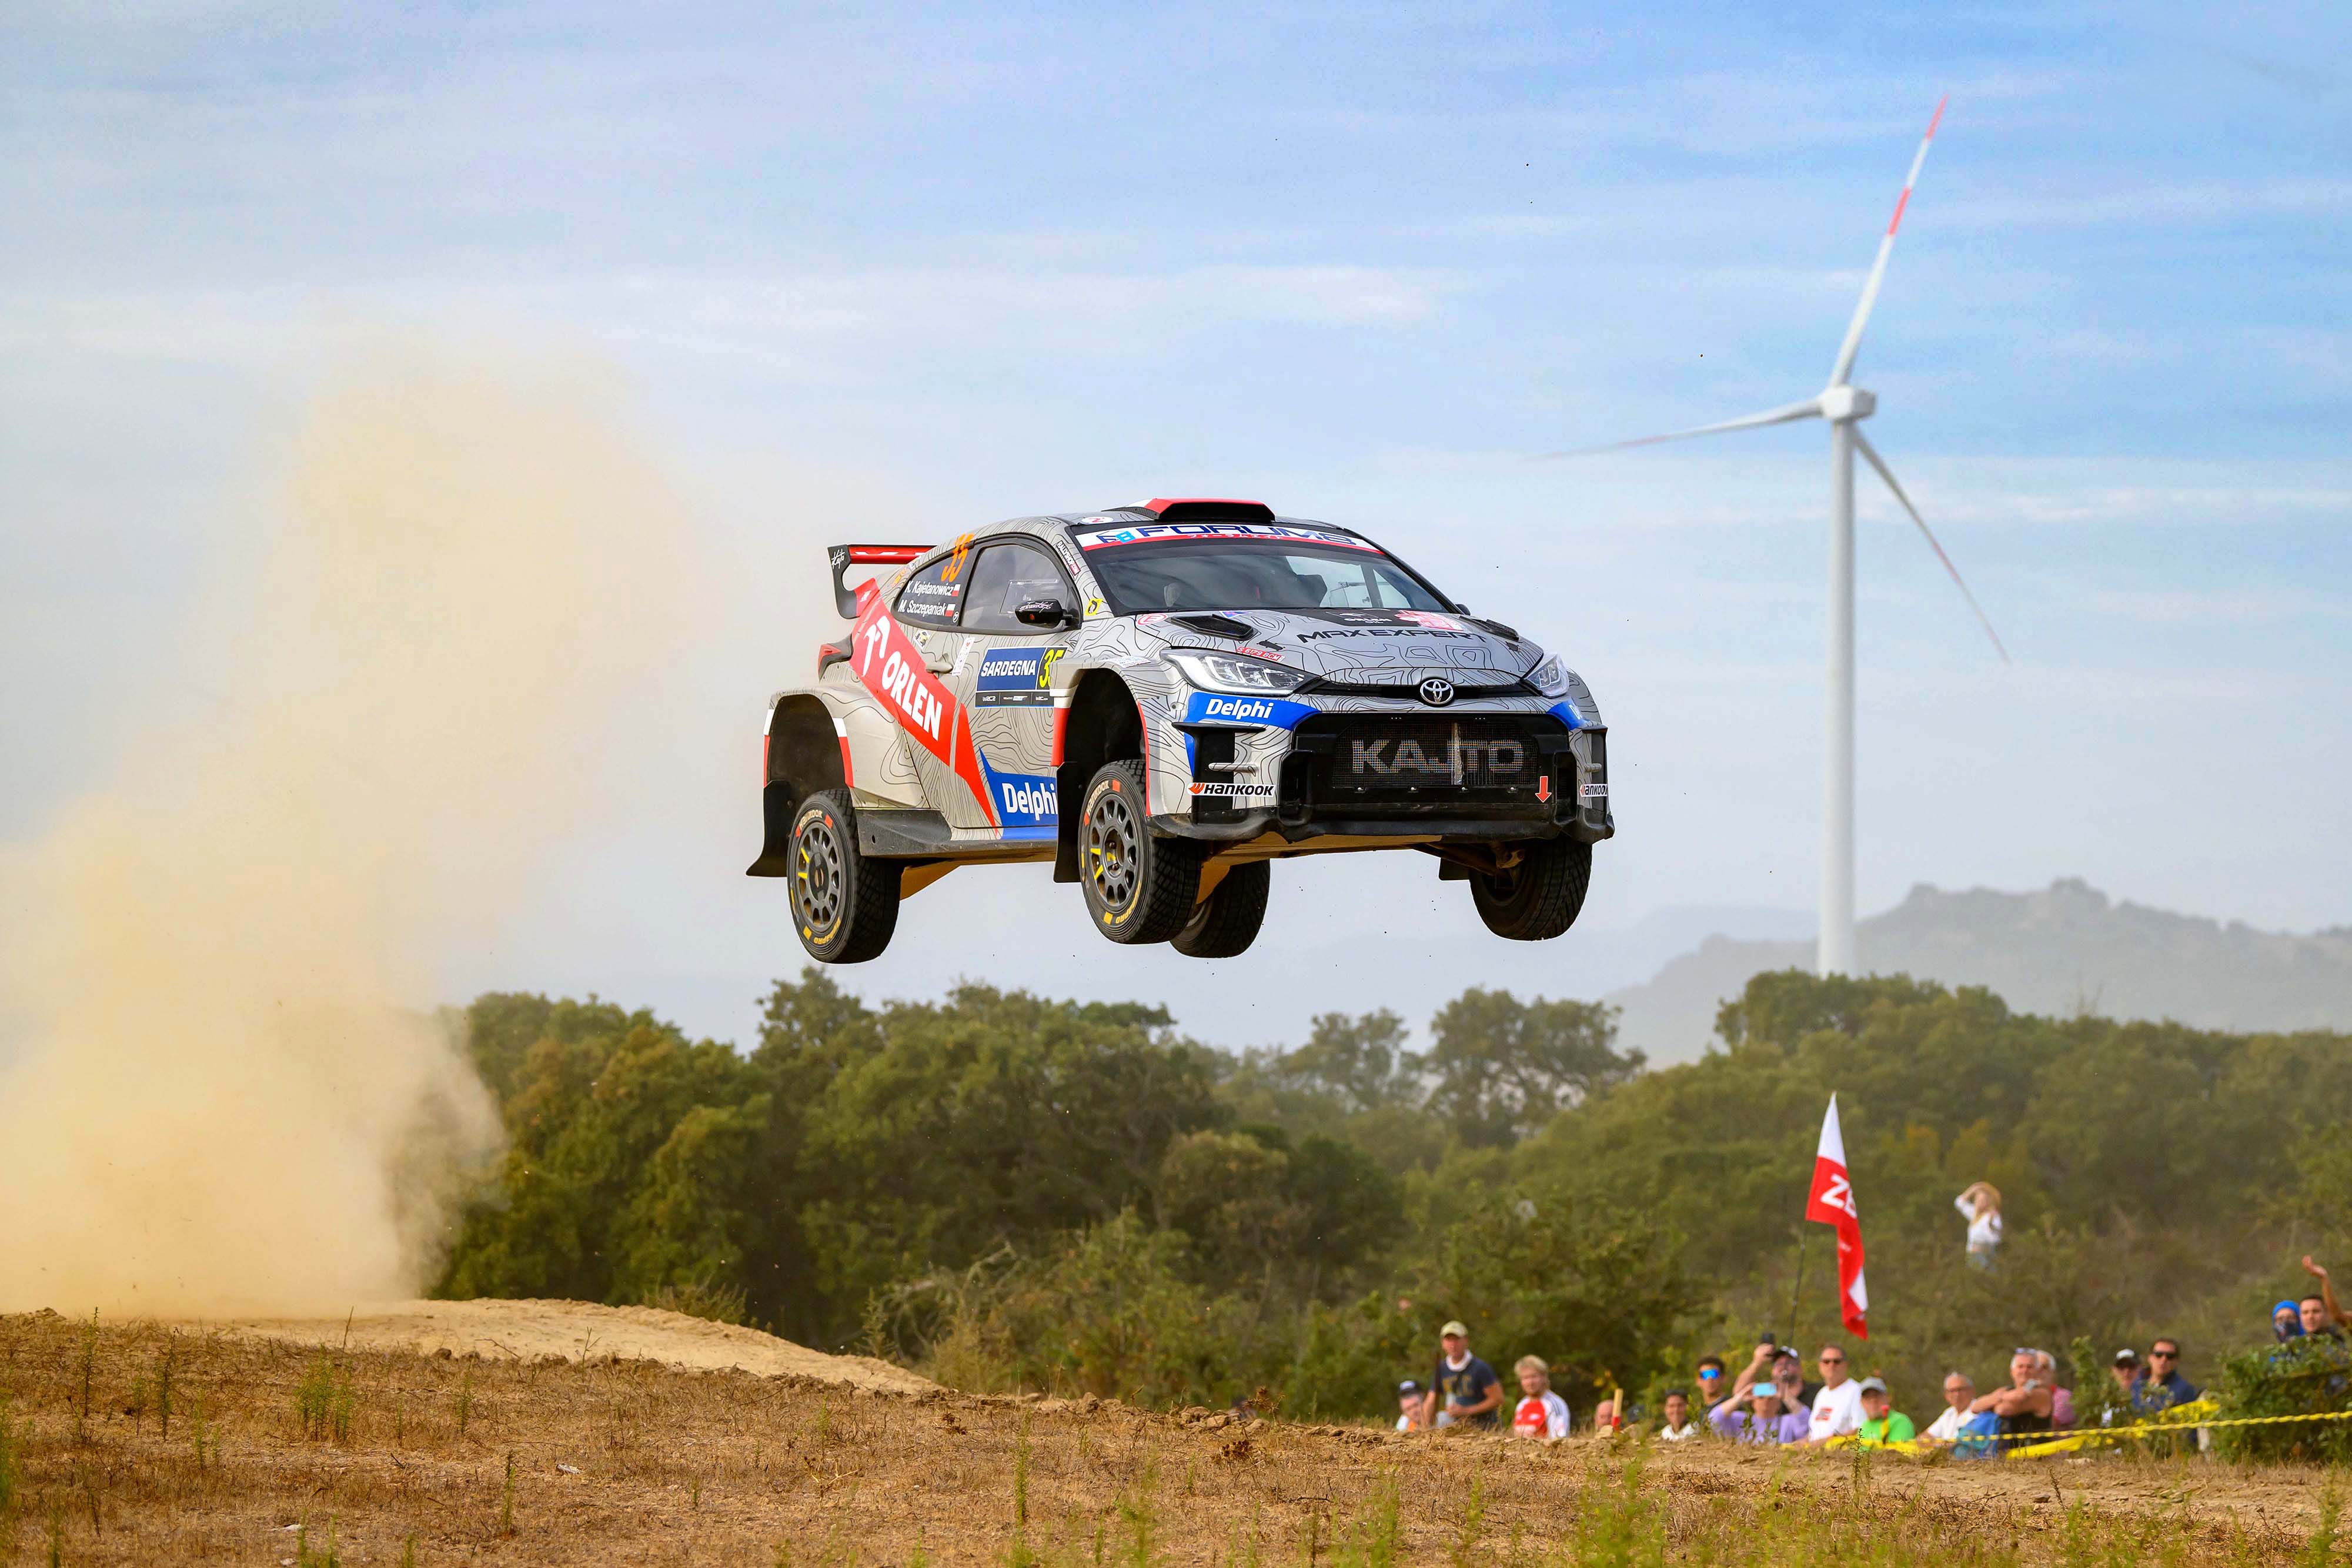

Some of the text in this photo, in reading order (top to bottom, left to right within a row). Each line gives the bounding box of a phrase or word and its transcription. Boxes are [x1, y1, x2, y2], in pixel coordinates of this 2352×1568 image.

[1136, 524, 1357, 545] FORUM8
[904, 580, 954, 596] K. Kajetanowicz
[898, 600, 947, 617] M. Szczepaniak
[1297, 630, 1487, 643] MAX EXPERT
[981, 660, 1037, 677] SARDEGNA
[881, 651, 943, 741] ORLEN
[1205, 698, 1275, 720] Delphi
[1352, 740, 1524, 773] KAJTO
[1001, 782, 1058, 821] Delphi
